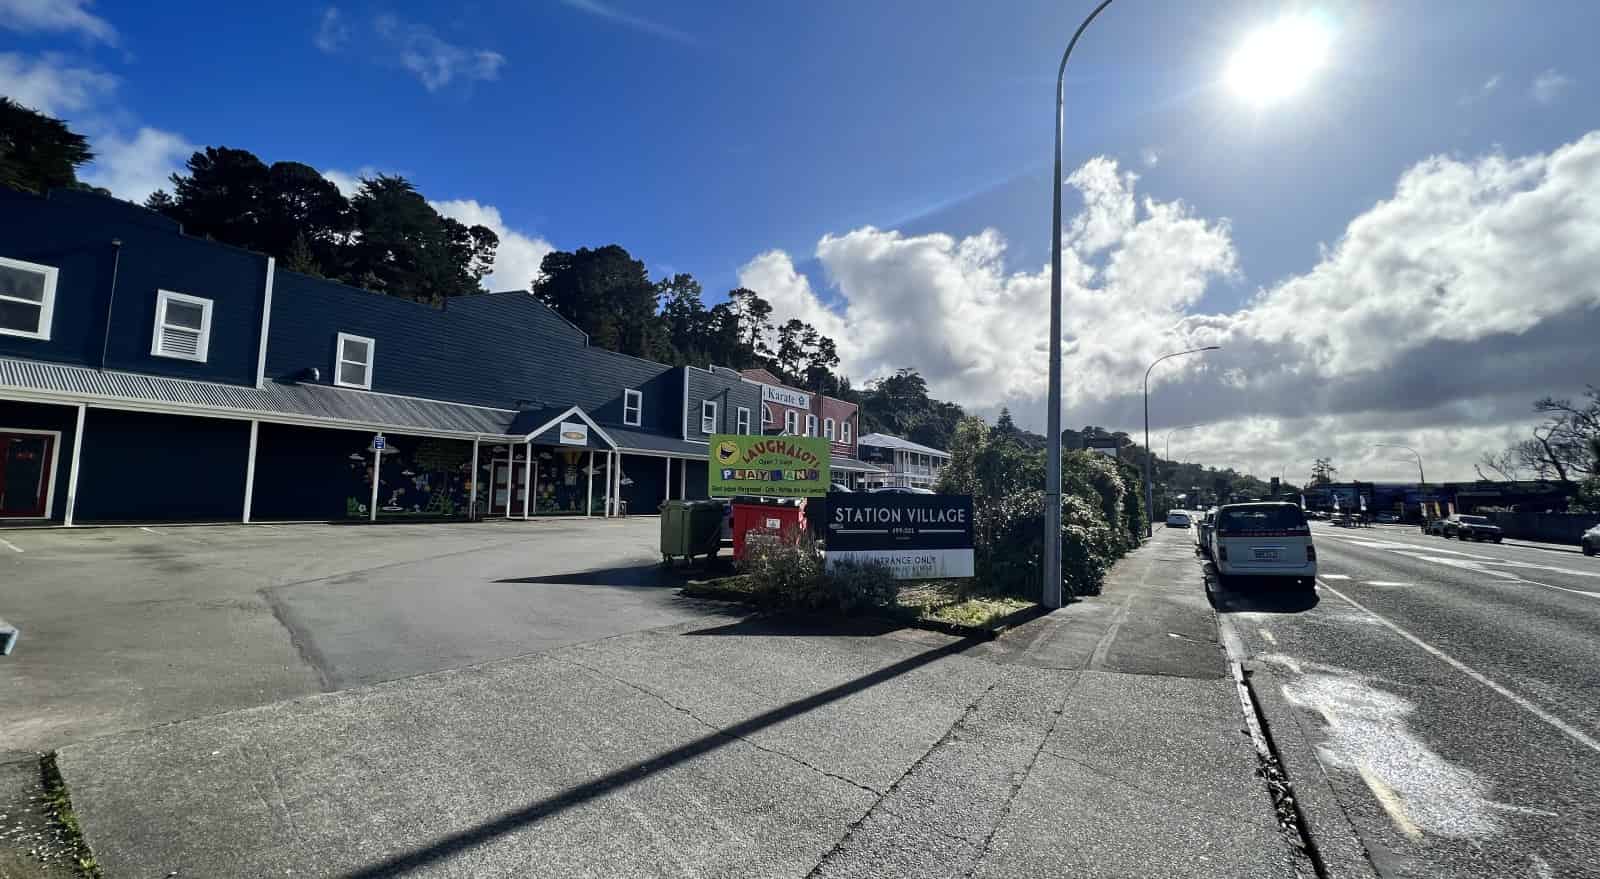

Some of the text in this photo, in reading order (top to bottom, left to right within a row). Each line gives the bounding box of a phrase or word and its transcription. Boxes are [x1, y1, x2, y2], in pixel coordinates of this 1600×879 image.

[768, 387, 796, 404] Karate
[721, 468, 819, 480] PLAYLAND
[835, 507, 966, 522] STATION VILLAGE
